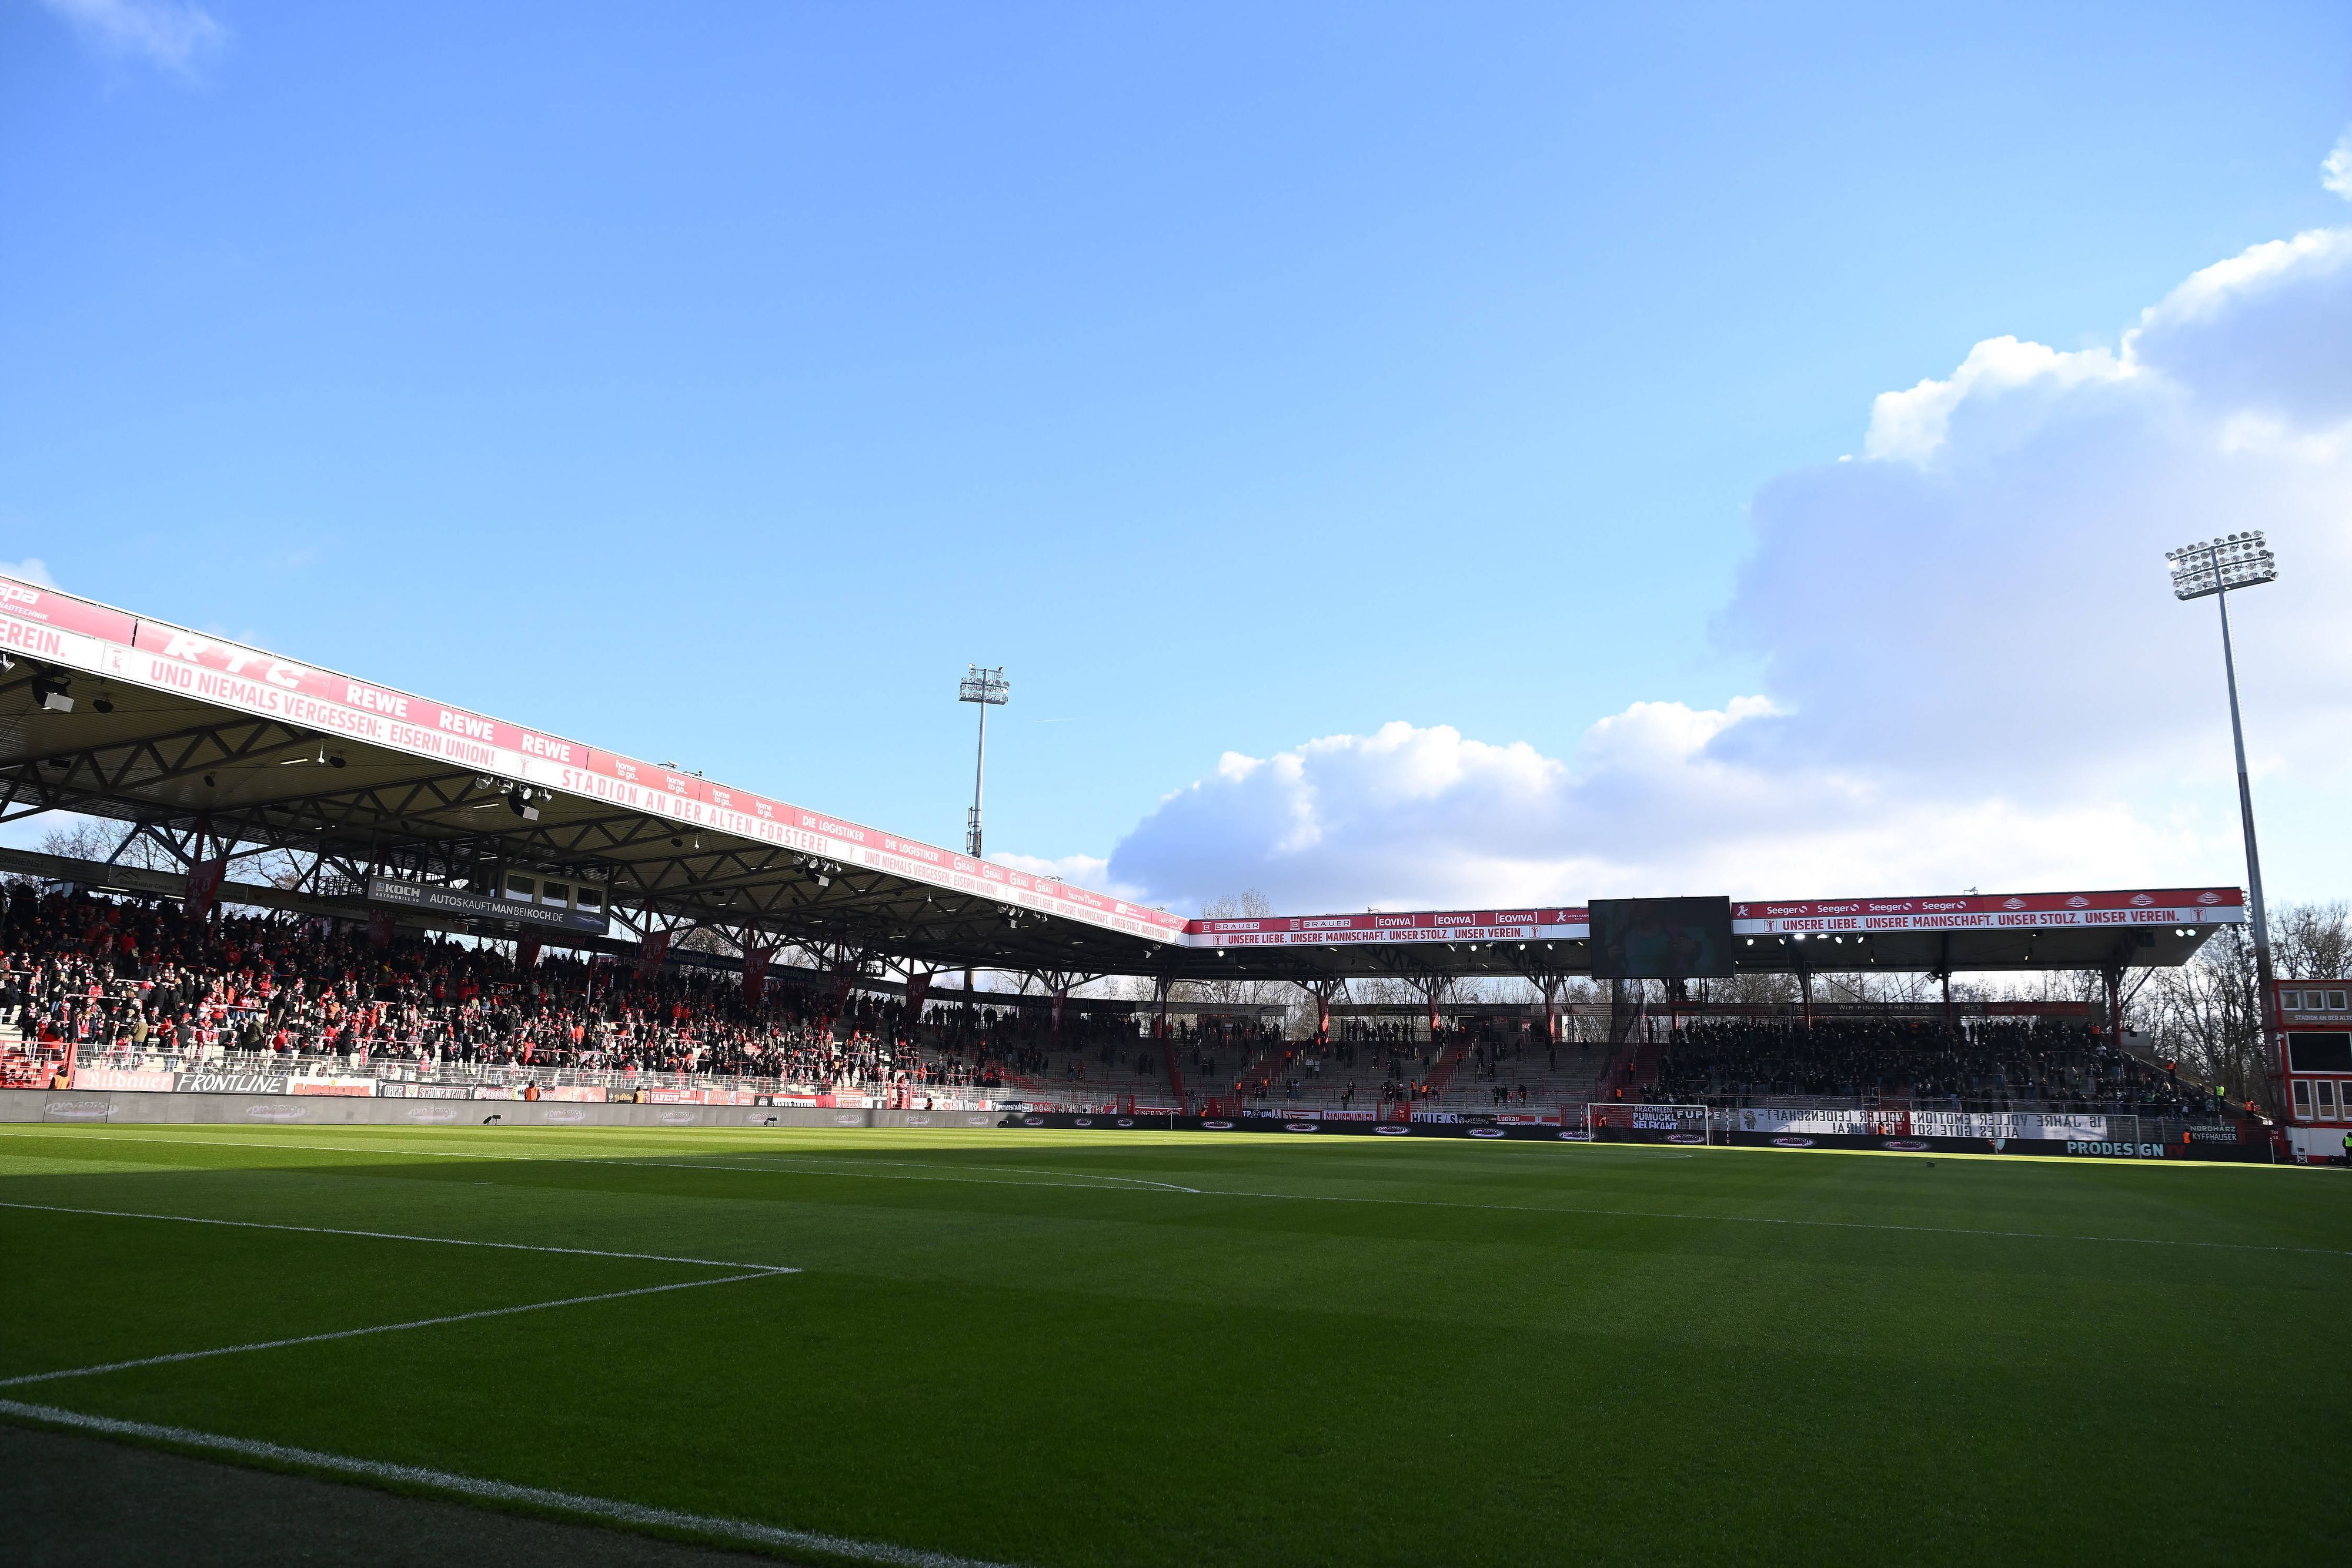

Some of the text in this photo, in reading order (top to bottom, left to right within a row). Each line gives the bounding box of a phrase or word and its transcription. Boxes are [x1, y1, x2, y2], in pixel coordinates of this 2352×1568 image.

[346, 683, 408, 718] REWE
[151, 660, 495, 767] UND NIEMALS VERGESSEN: EISERN UNION!
[439, 709, 495, 741] REWE
[521, 733, 571, 763] REWE
[616, 759, 636, 773] home
[666, 774, 685, 787] home
[713, 788, 730, 800] home
[562, 768, 828, 854] STADION AN DER ALTEN FÖRSTEREI
[756, 800, 773, 812] home
[803, 815, 865, 842] DIE LOGISTIKER
[885, 838, 939, 862] DIE LOGISTIKER
[864, 850, 998, 896] UND NIEMALS VERGESSEN: EISERN UNION!
[375, 892, 412, 902] AUTOMOBILE
[386, 883, 421, 898] KOCH
[1018, 891, 1040, 907] UNSERE
[1057, 901, 1077, 917] UNSERE
[1077, 907, 1110, 925] MANNSCHAFT.
[1111, 916, 1127, 930] UNSER
[1127, 921, 1141, 933] STOLZ.
[1141, 925, 1155, 937] UNSER
[1766, 905, 1799, 915] Seeger
[1817, 904, 1850, 914] Seeger
[1869, 902, 1903, 912] Seeger
[1922, 901, 1956, 911] Seeger
[1782, 910, 2180, 931] UNSERE LIEBE. UNSERE MANNSCHAFT. UNSER STOLZ. UNSER VEREIN.
[1228, 927, 1524, 945] UNSERE LIEBE. UNSERE MANNSCHAFT. UNSER STOLZ. UNSER VEREIN.
[176, 1073, 285, 1094] FRONTLINE
[1633, 1112, 1677, 1121] PUMUCKL
[1634, 1105, 1672, 1114] BRACHELEN
[2067, 1140, 2164, 1157] PRODESIGN
